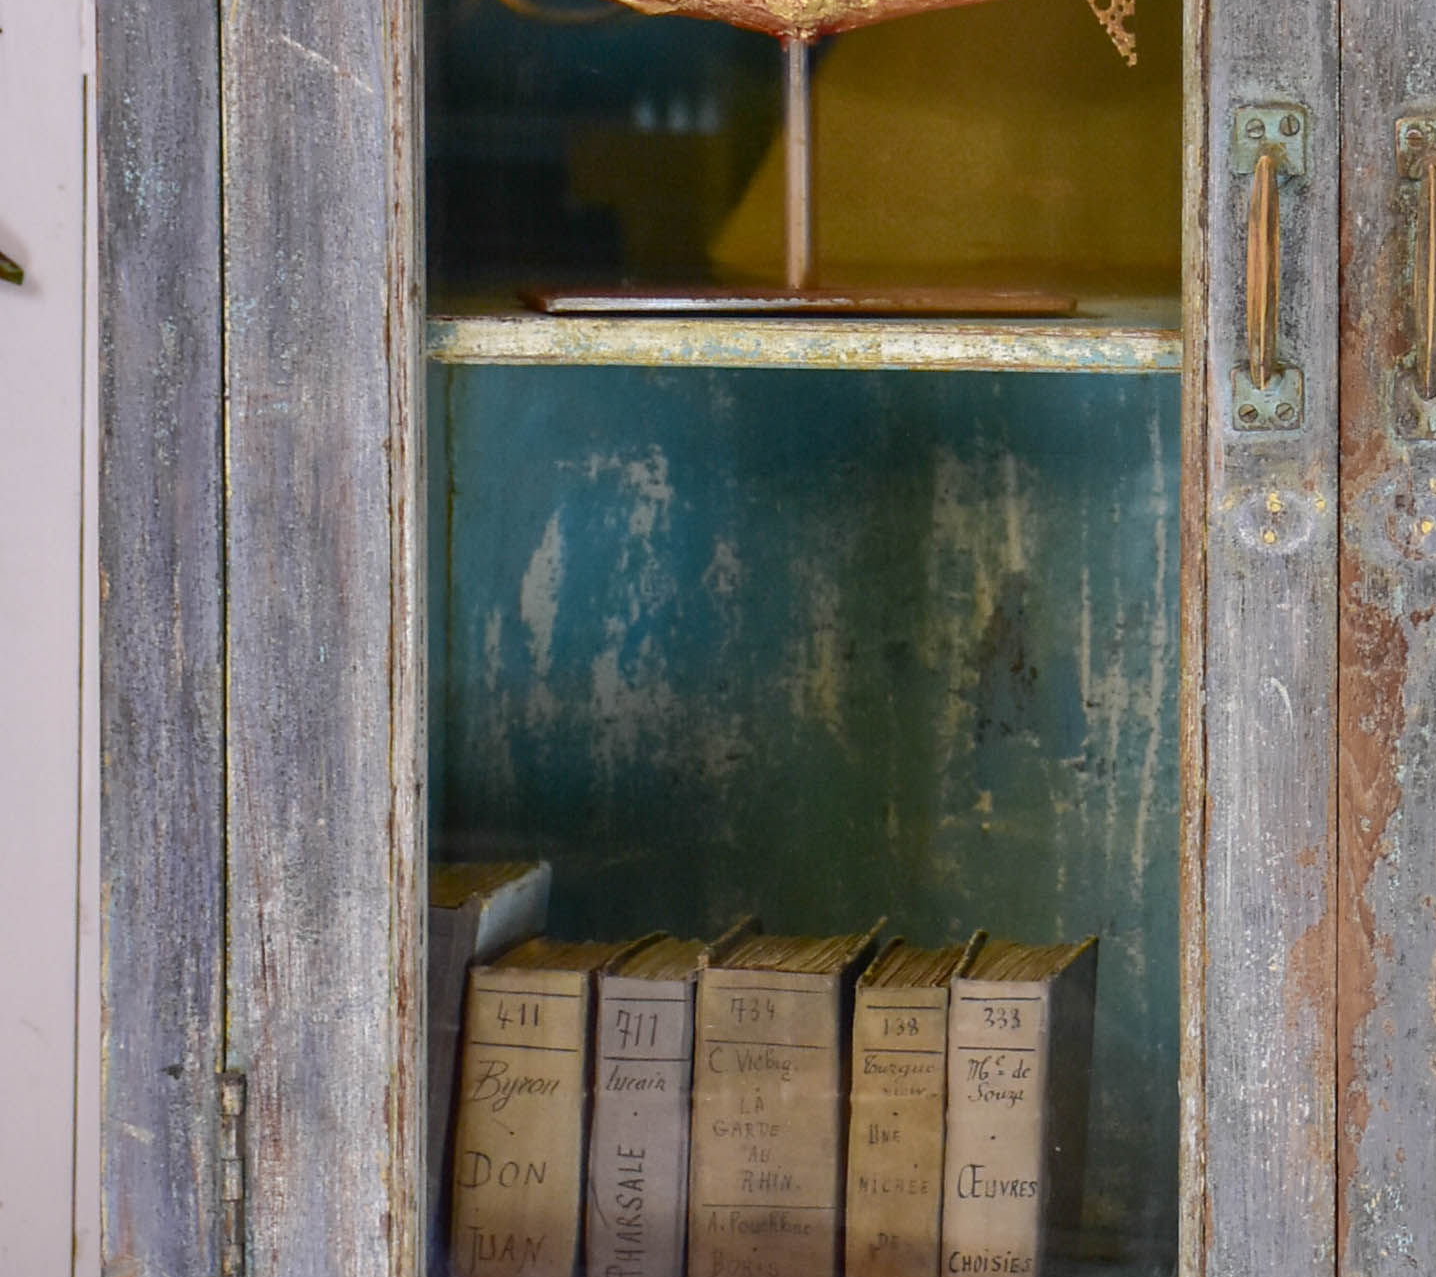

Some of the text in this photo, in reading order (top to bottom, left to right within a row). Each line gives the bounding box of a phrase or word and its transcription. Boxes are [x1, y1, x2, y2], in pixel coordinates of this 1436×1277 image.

[497, 1000, 539, 1029] 411
[730, 997, 776, 1023] 734
[984, 1007, 1021, 1029] 333
[616, 1009, 658, 1049] 711
[883, 1017, 919, 1037] 138
[1011, 1059, 1031, 1079] de
[471, 1059, 560, 1112] Byron
[740, 1095, 765, 1115] LA
[712, 1120, 781, 1139] GARDE
[868, 1123, 901, 1145] UNE
[747, 1145, 772, 1164] AU
[458, 1150, 547, 1189] DON
[948, 1249, 1032, 1275] CHOISIES
